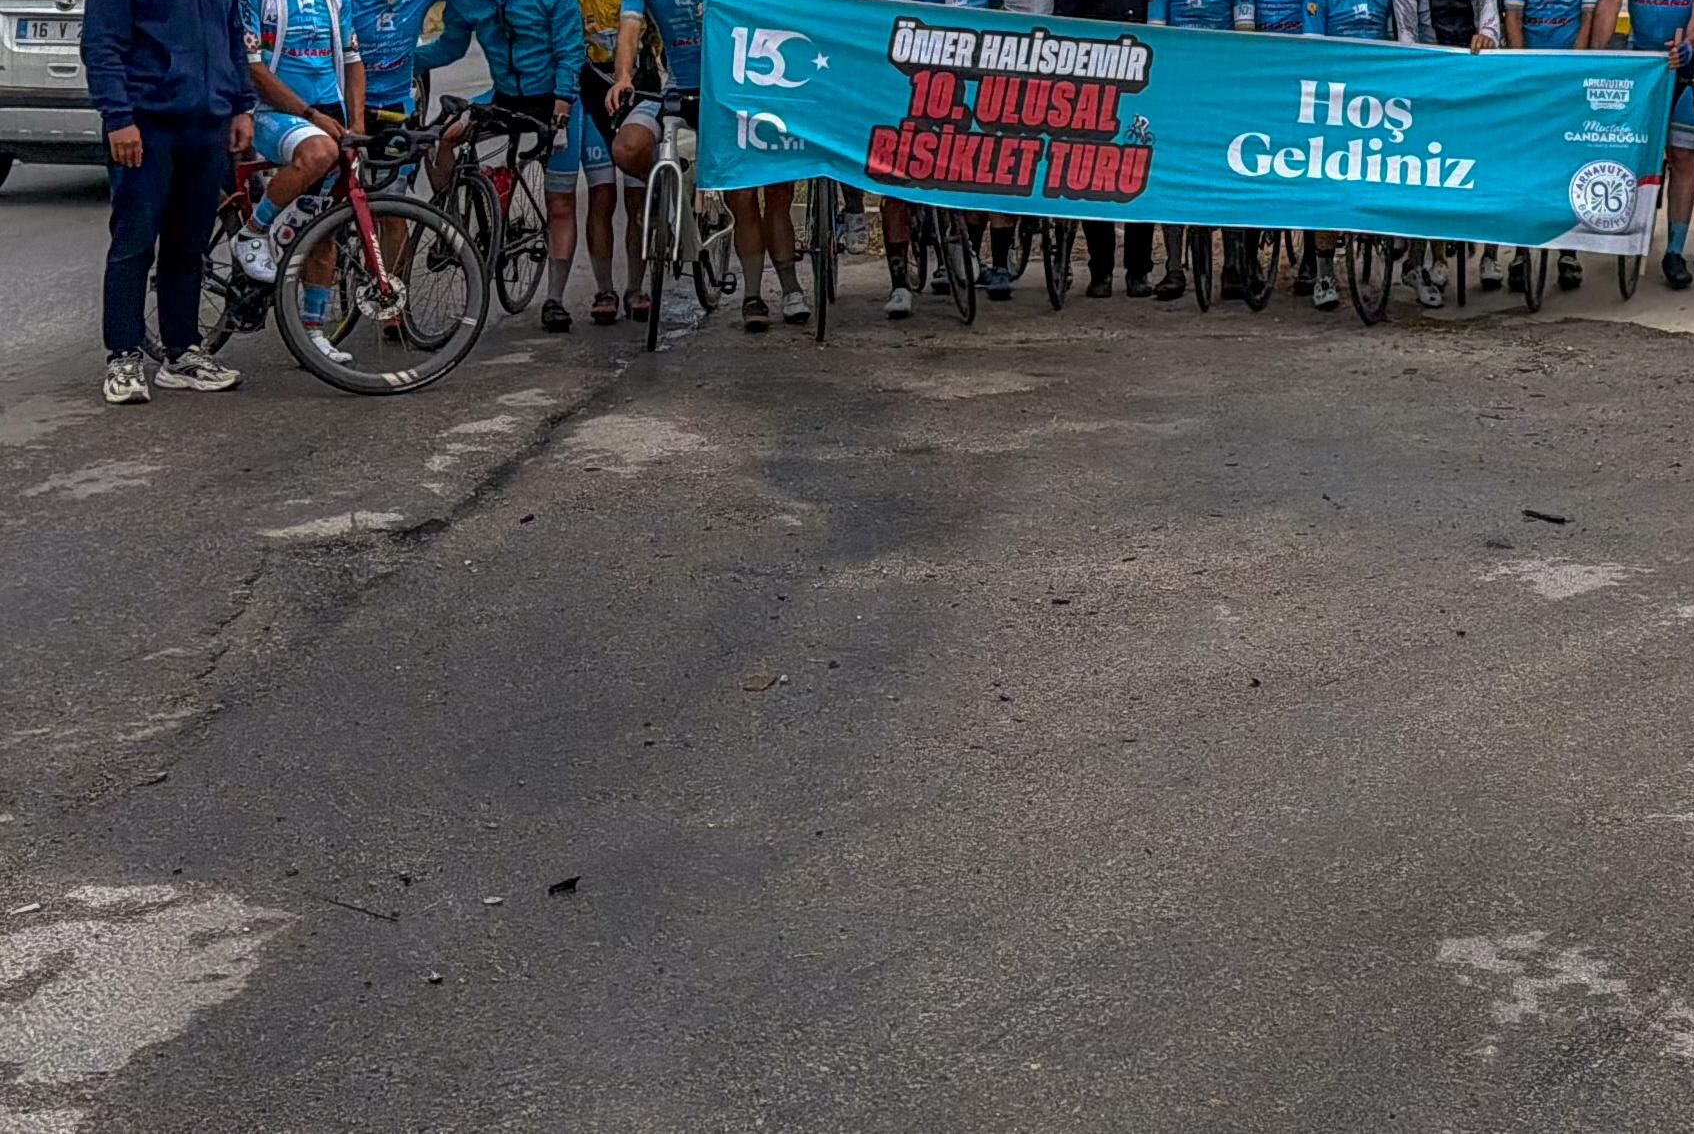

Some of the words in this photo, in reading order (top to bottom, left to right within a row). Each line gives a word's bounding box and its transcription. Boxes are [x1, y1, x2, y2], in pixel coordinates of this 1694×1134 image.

[32, 22, 48, 38] 16
[60, 23, 67, 38] V
[731, 27, 802, 88] 15
[892, 20, 977, 67] ÖMER
[979, 31, 1148, 81] HALİSDEMİR
[911, 70, 965, 120] 10.
[976, 76, 1117, 131] ULUSAL
[1297, 79, 1413, 144] Hoş
[1589, 90, 1628, 101] HAYAT
[586, 147, 602, 161] 10
[868, 122, 1041, 186] BİSİKLET
[1048, 141, 1149, 194] TURU
[1227, 132, 1476, 189] Geldiniz
[1575, 164, 1636, 194] ARNAVUTKÖY
